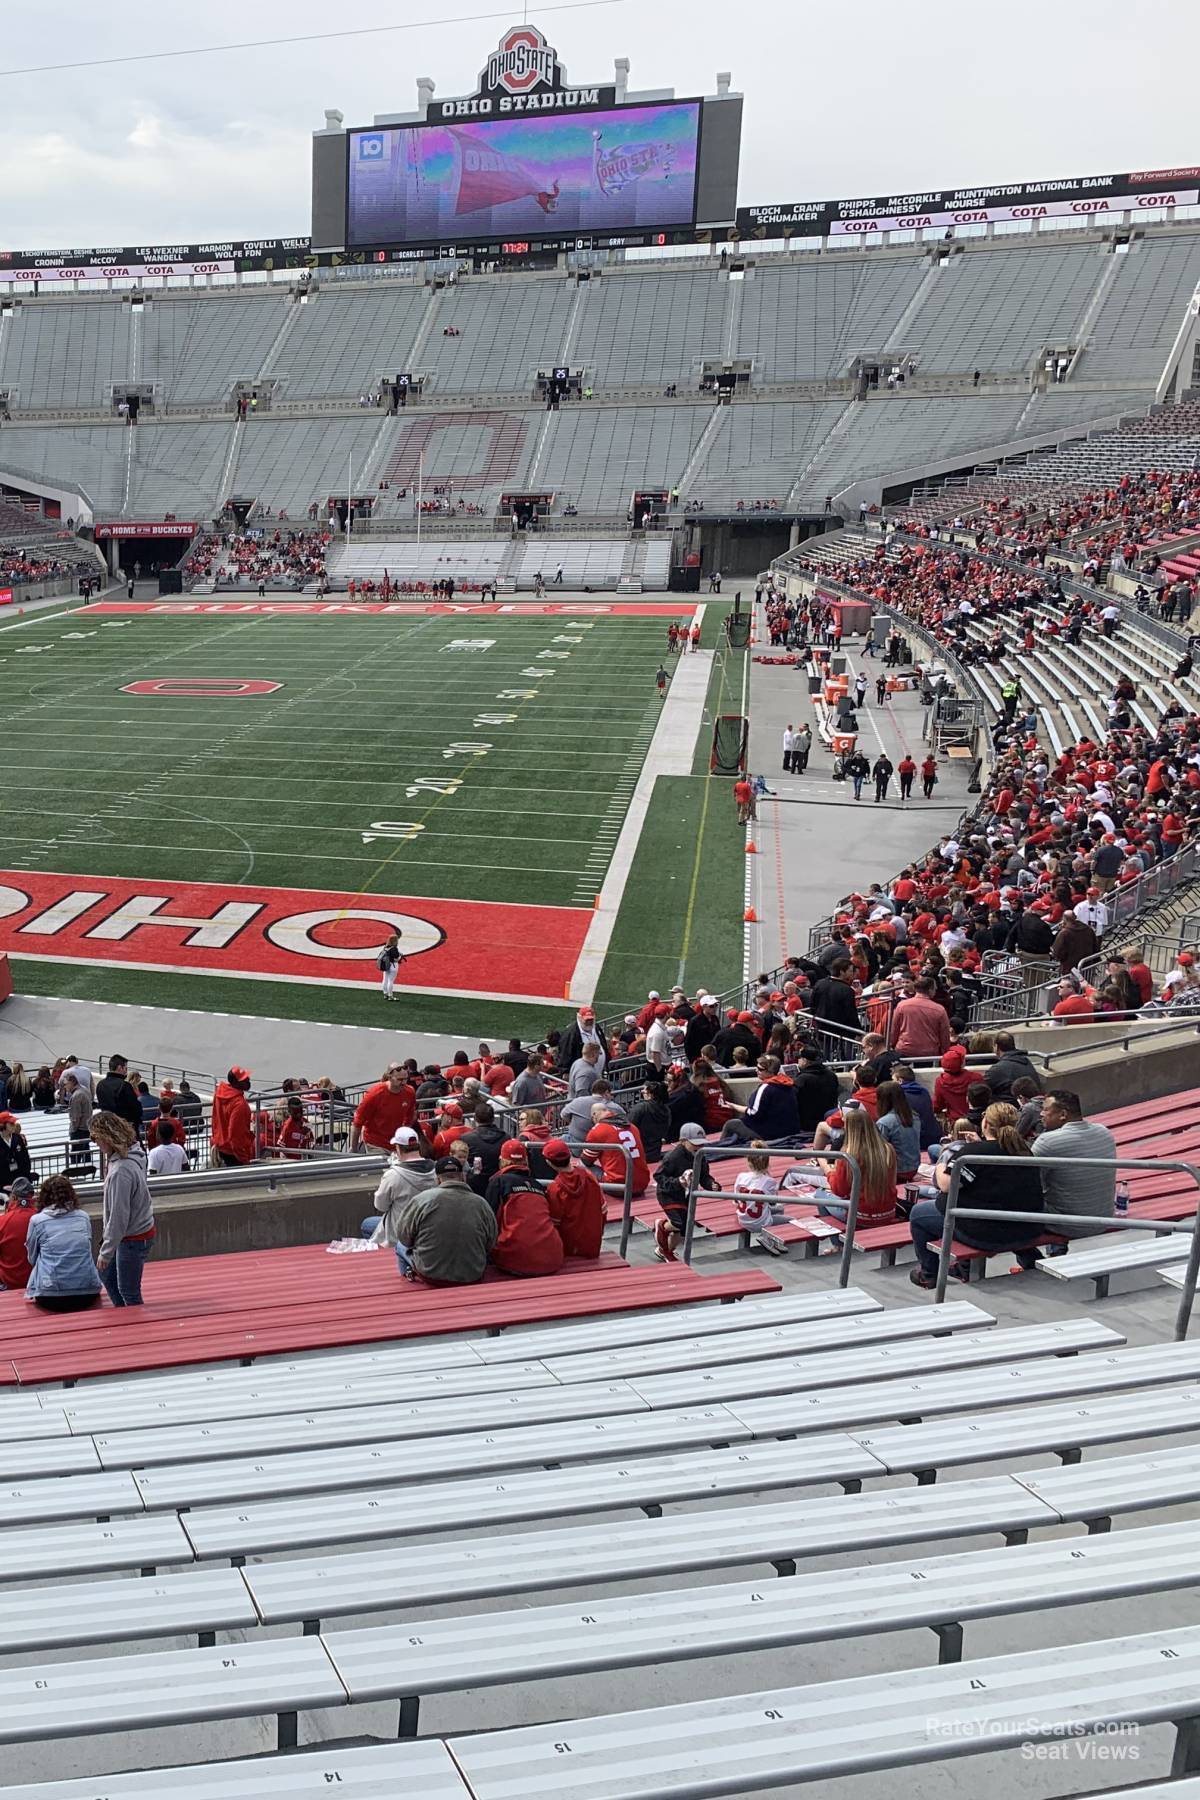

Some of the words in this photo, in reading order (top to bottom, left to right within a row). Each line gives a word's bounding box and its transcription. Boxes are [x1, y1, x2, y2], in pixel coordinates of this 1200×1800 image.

[441, 99, 492, 117] OHIO
[500, 88, 600, 112] STADIUM
[954, 186, 1022, 200] HUNTINGTON
[1026, 181, 1080, 194] NATIONAL
[1082, 176, 1113, 188] BANK
[838, 200, 876, 210] PHIPPS
[944, 197, 986, 210] NOURSE
[1138, 194, 1176, 207] COTA
[749, 206, 781, 217] BLOCH
[793, 203, 826, 213] CRANE
[1011, 206, 1047, 218] COTA
[1072, 201, 1110, 212] COTA
[756, 212, 818, 224] SCHUMAKER
[898, 217, 932, 228] COTA
[954, 211, 988, 223] COTA
[844, 221, 878, 232] COTA
[243, 241, 277, 250] COVELLI
[282, 239, 310, 247] WELLS
[609, 237, 625, 246] GRAY
[135, 248, 151, 256] LES
[152, 246, 189, 255] WEXNER
[198, 244, 233, 253] HARMON
[215, 251, 243, 259] WOLFE
[245, 249, 262, 257] FDN
[398, 250, 424, 258] SCARLET
[34, 259, 65, 267] CRONIN
[89, 256, 117, 265] McCOY
[143, 254, 183, 262] WANDELL
[59, 270, 86, 278] COTA
[102, 268, 130, 277] COTA
[147, 266, 174, 275] COTA
[194, 264, 221, 273] COTA
[15, 271, 42, 280] COTA
[112, 527, 135, 535] HOME
[152, 526, 193, 535] BUCKEYES
[146, 603, 614, 614] BUCKEYES
[441, 742, 494, 756] 30
[405, 777, 465, 795] 20
[360, 821, 426, 840] 10
[618, 1130, 640, 1160] 2
[751, 1593, 764, 1603] 17
[409, 1637, 424, 1646] 15
[1160, 1648, 1180, 1659] 18
[222, 1659, 237, 1669] 14
[35, 1679, 48, 1690] 13
[970, 1679, 987, 1690] 17
[765, 1709, 784, 1721] 16
[554, 1742, 572, 1754] 15
[324, 1771, 343, 1784] 14
